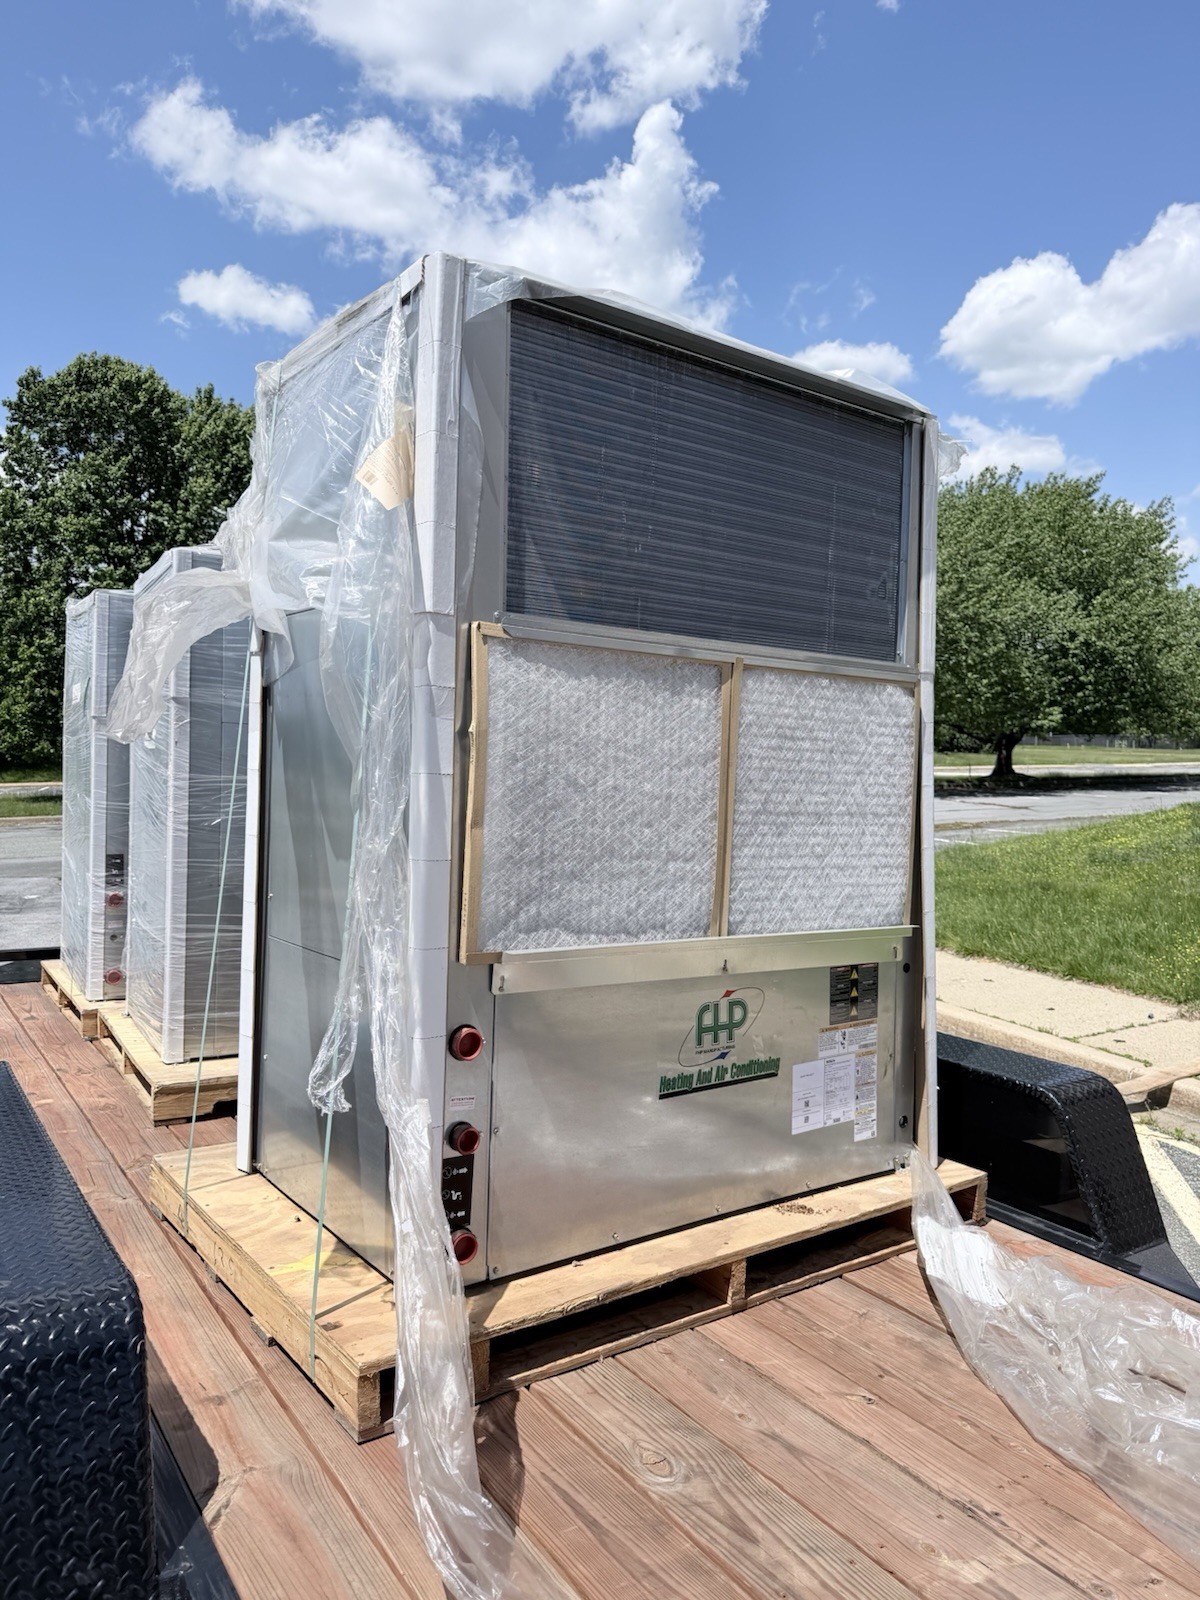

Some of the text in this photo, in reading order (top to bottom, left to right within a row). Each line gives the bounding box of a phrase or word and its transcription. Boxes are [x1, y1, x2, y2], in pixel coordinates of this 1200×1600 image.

[659, 1056, 781, 1093] Heating And Air Conditioning
